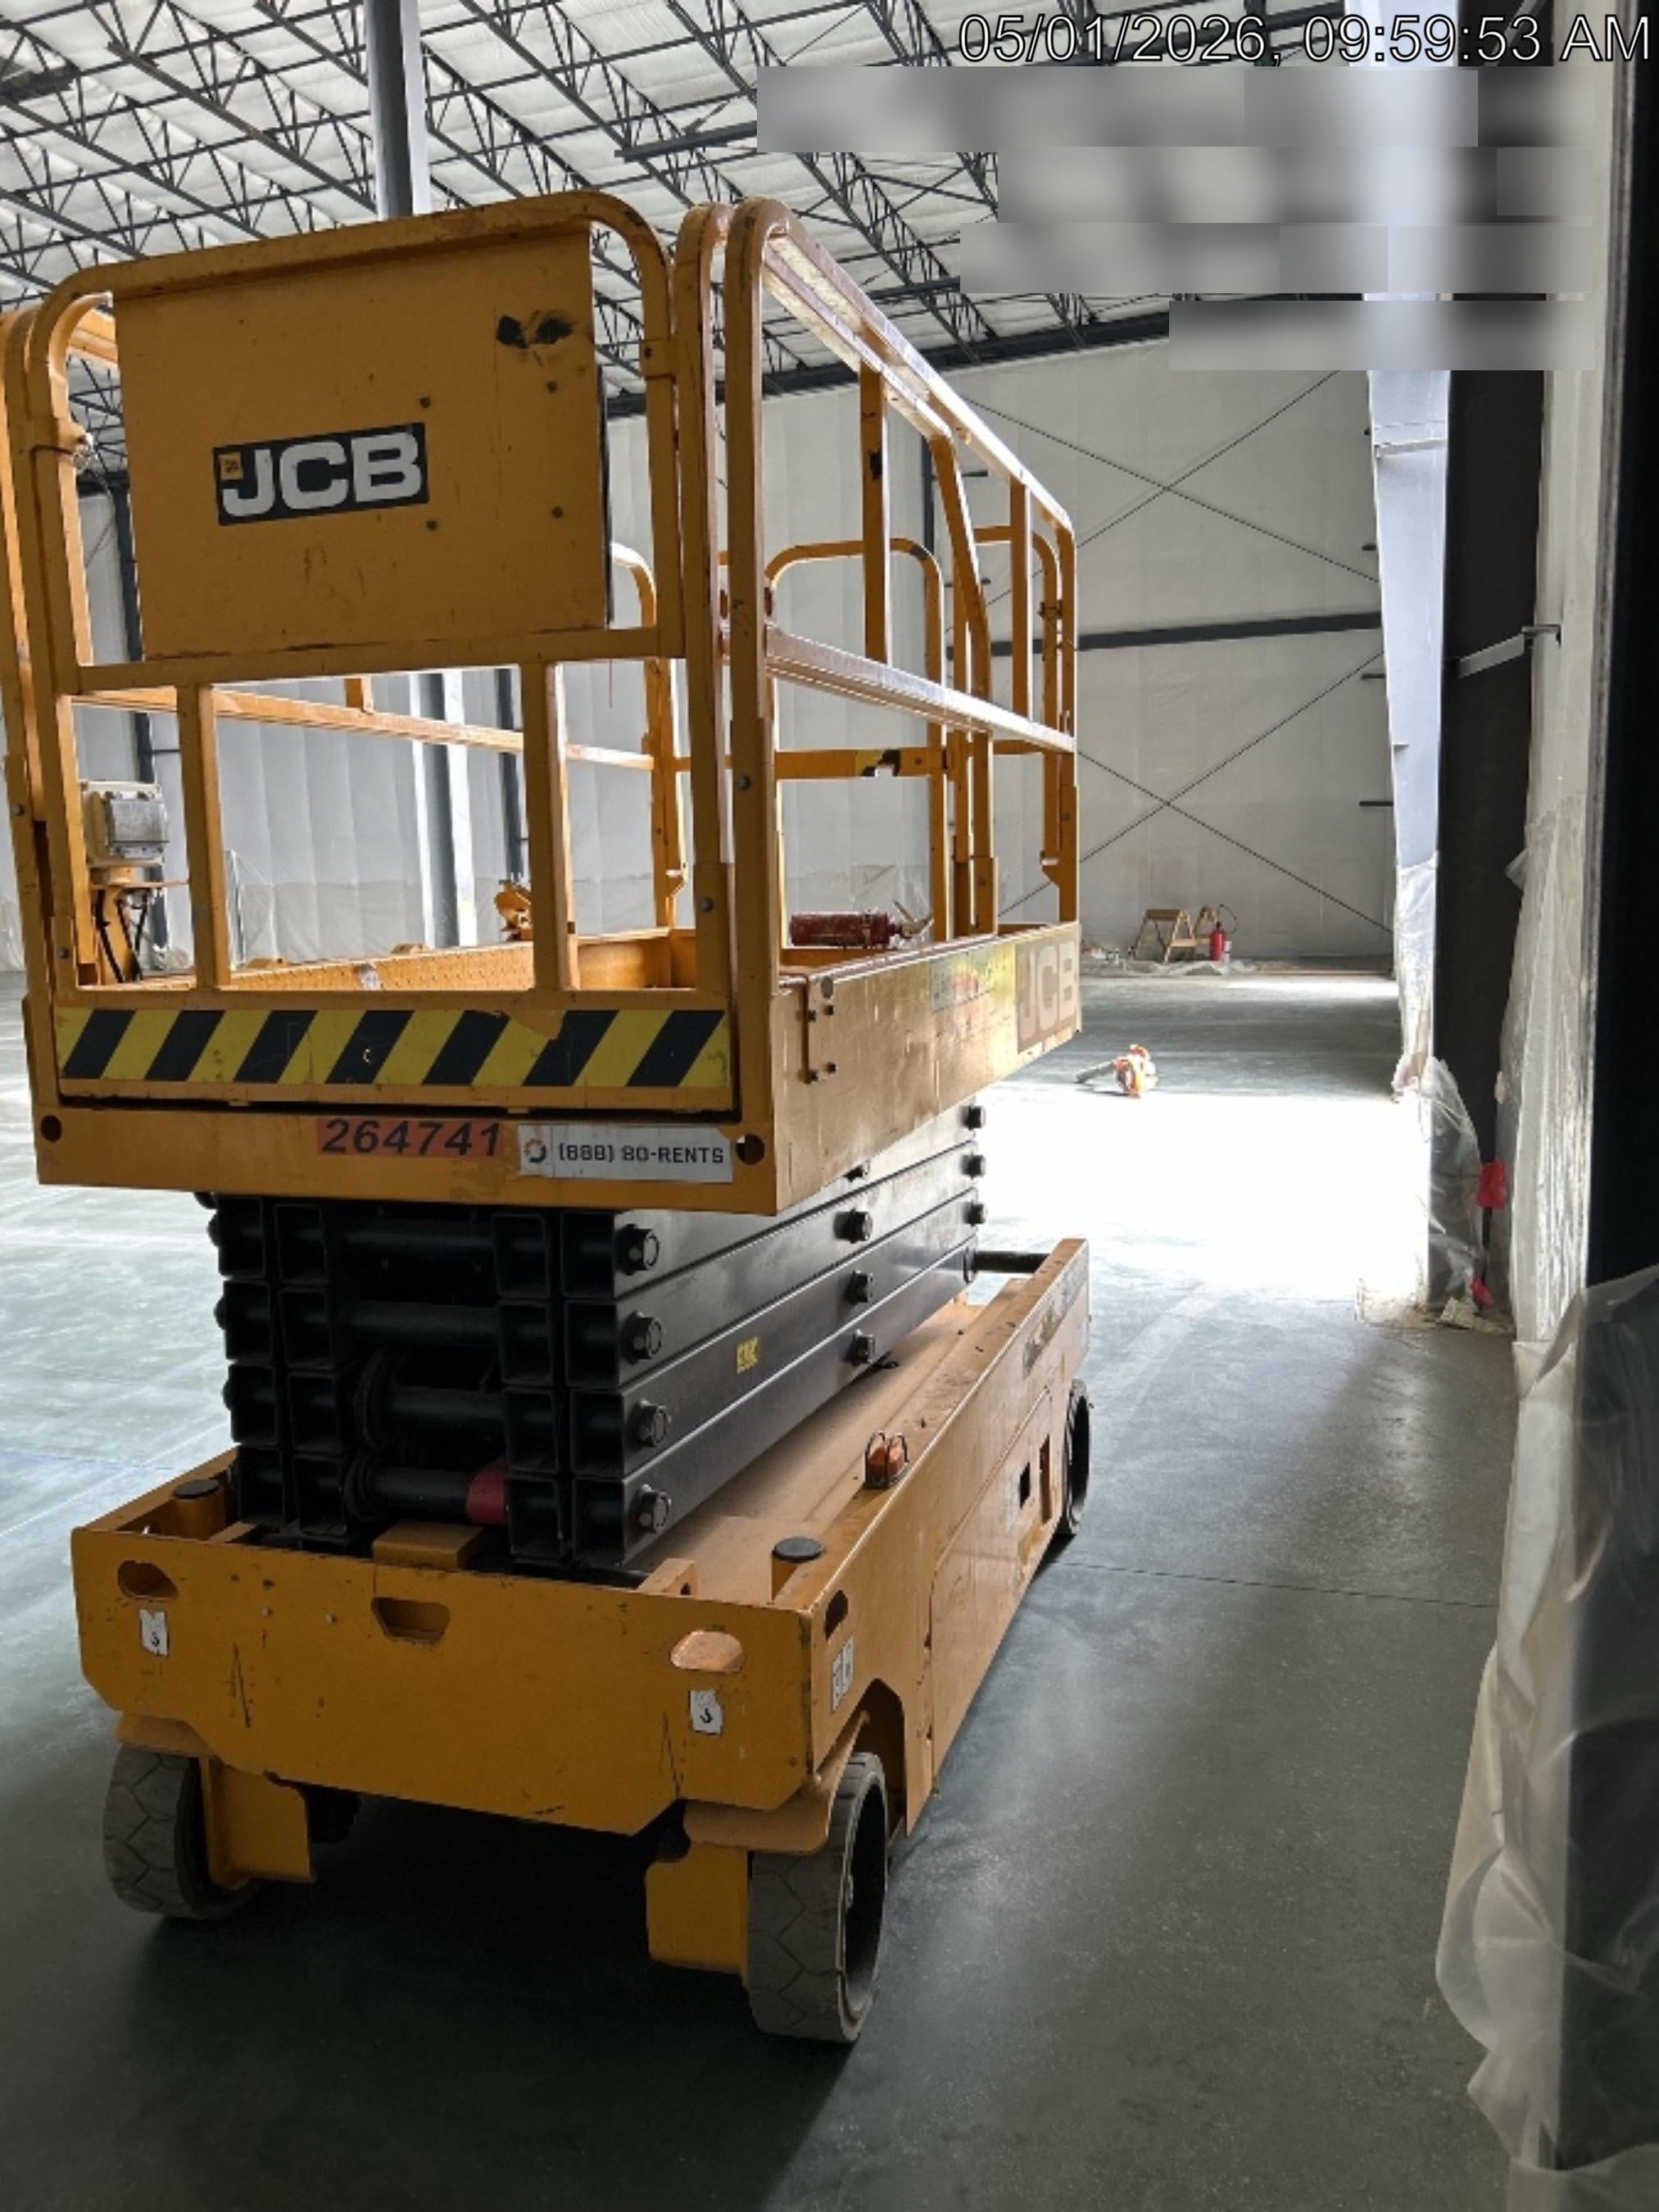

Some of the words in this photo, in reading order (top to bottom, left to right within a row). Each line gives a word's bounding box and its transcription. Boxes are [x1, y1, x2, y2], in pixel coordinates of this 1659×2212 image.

[221, 432, 422, 516] JCB
[1019, 941, 1077, 1040] JCB
[321, 1118, 500, 1155] 264741
[560, 1143, 614, 1163] (888)
[621, 1146, 723, 1163] 80-RENTS
